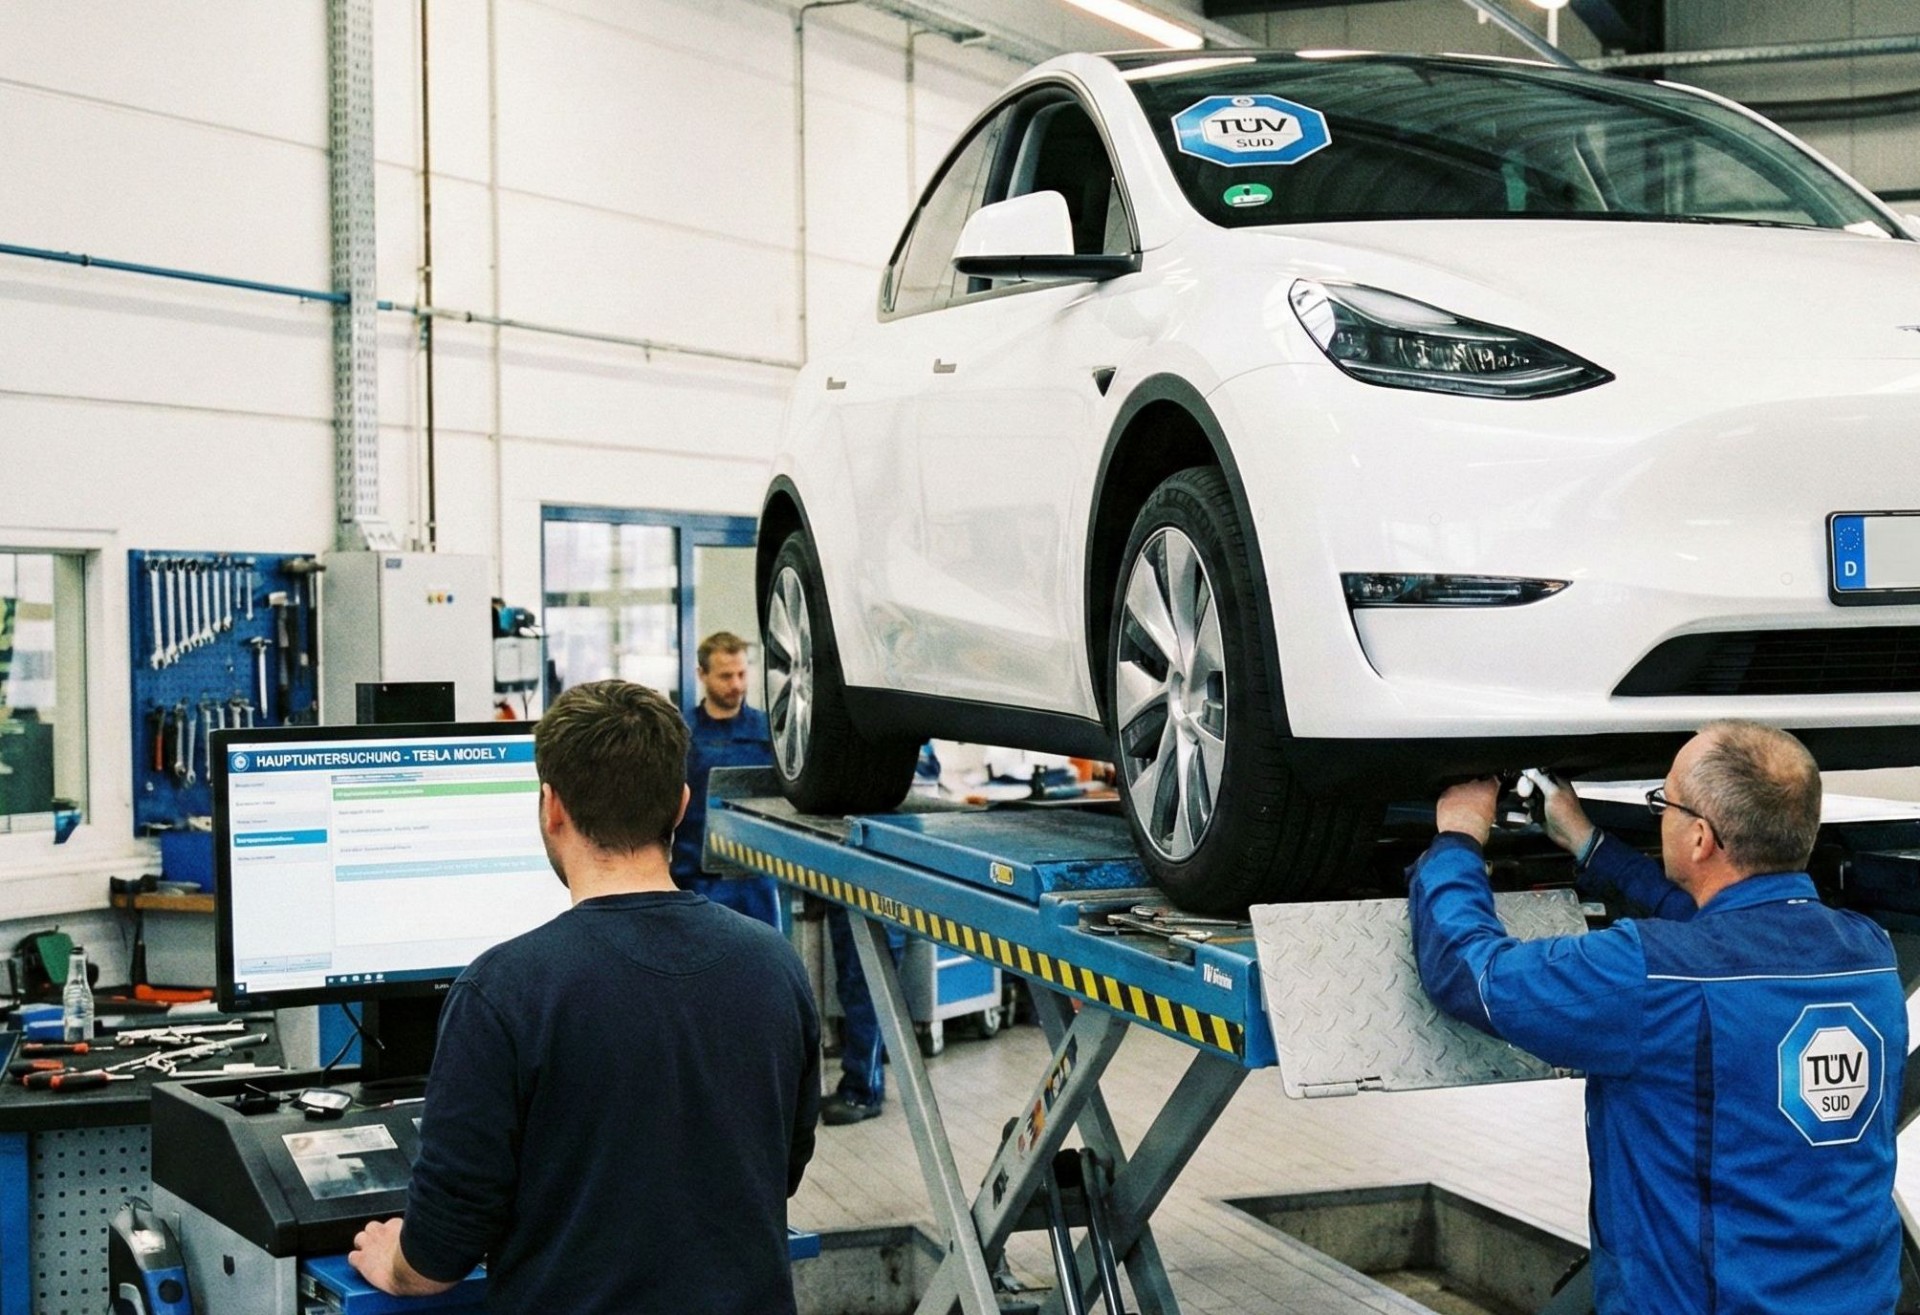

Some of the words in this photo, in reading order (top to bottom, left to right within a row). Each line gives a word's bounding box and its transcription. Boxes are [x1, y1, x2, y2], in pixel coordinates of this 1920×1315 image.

[1211, 118, 1288, 134] TÜV
[1844, 560, 1857, 577] D
[256, 751, 401, 768] HAUPTUNTERSUCHUNG
[412, 748, 451, 762] TESLA
[453, 747, 496, 761] MODEL
[498, 746, 507, 760] Y
[1806, 1051, 1863, 1086] TÜV
